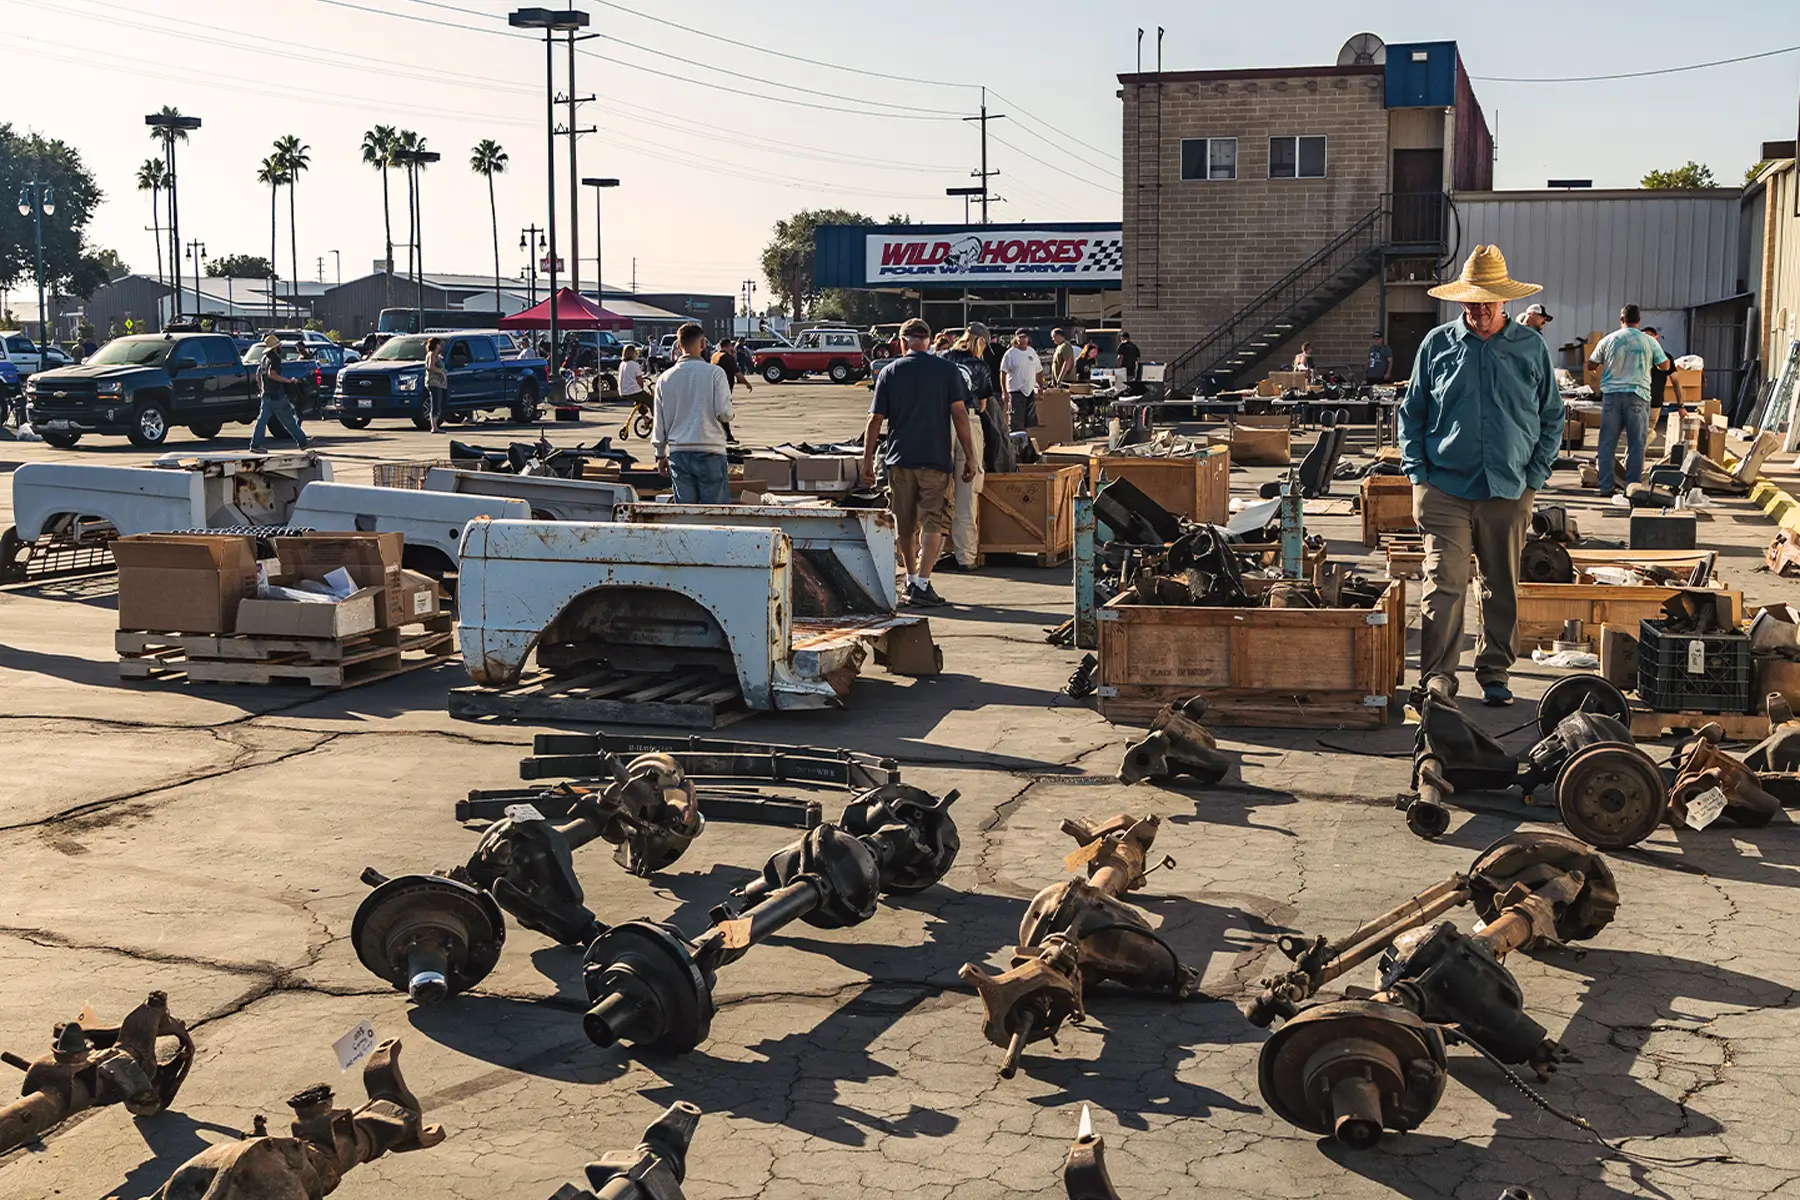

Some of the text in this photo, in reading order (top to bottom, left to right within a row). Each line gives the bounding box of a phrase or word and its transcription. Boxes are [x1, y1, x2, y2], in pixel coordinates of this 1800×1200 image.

[881, 239, 1088, 265] WILD HORSES
[879, 266, 937, 275] FOUR
[1014, 265, 1077, 273] DRIVE
